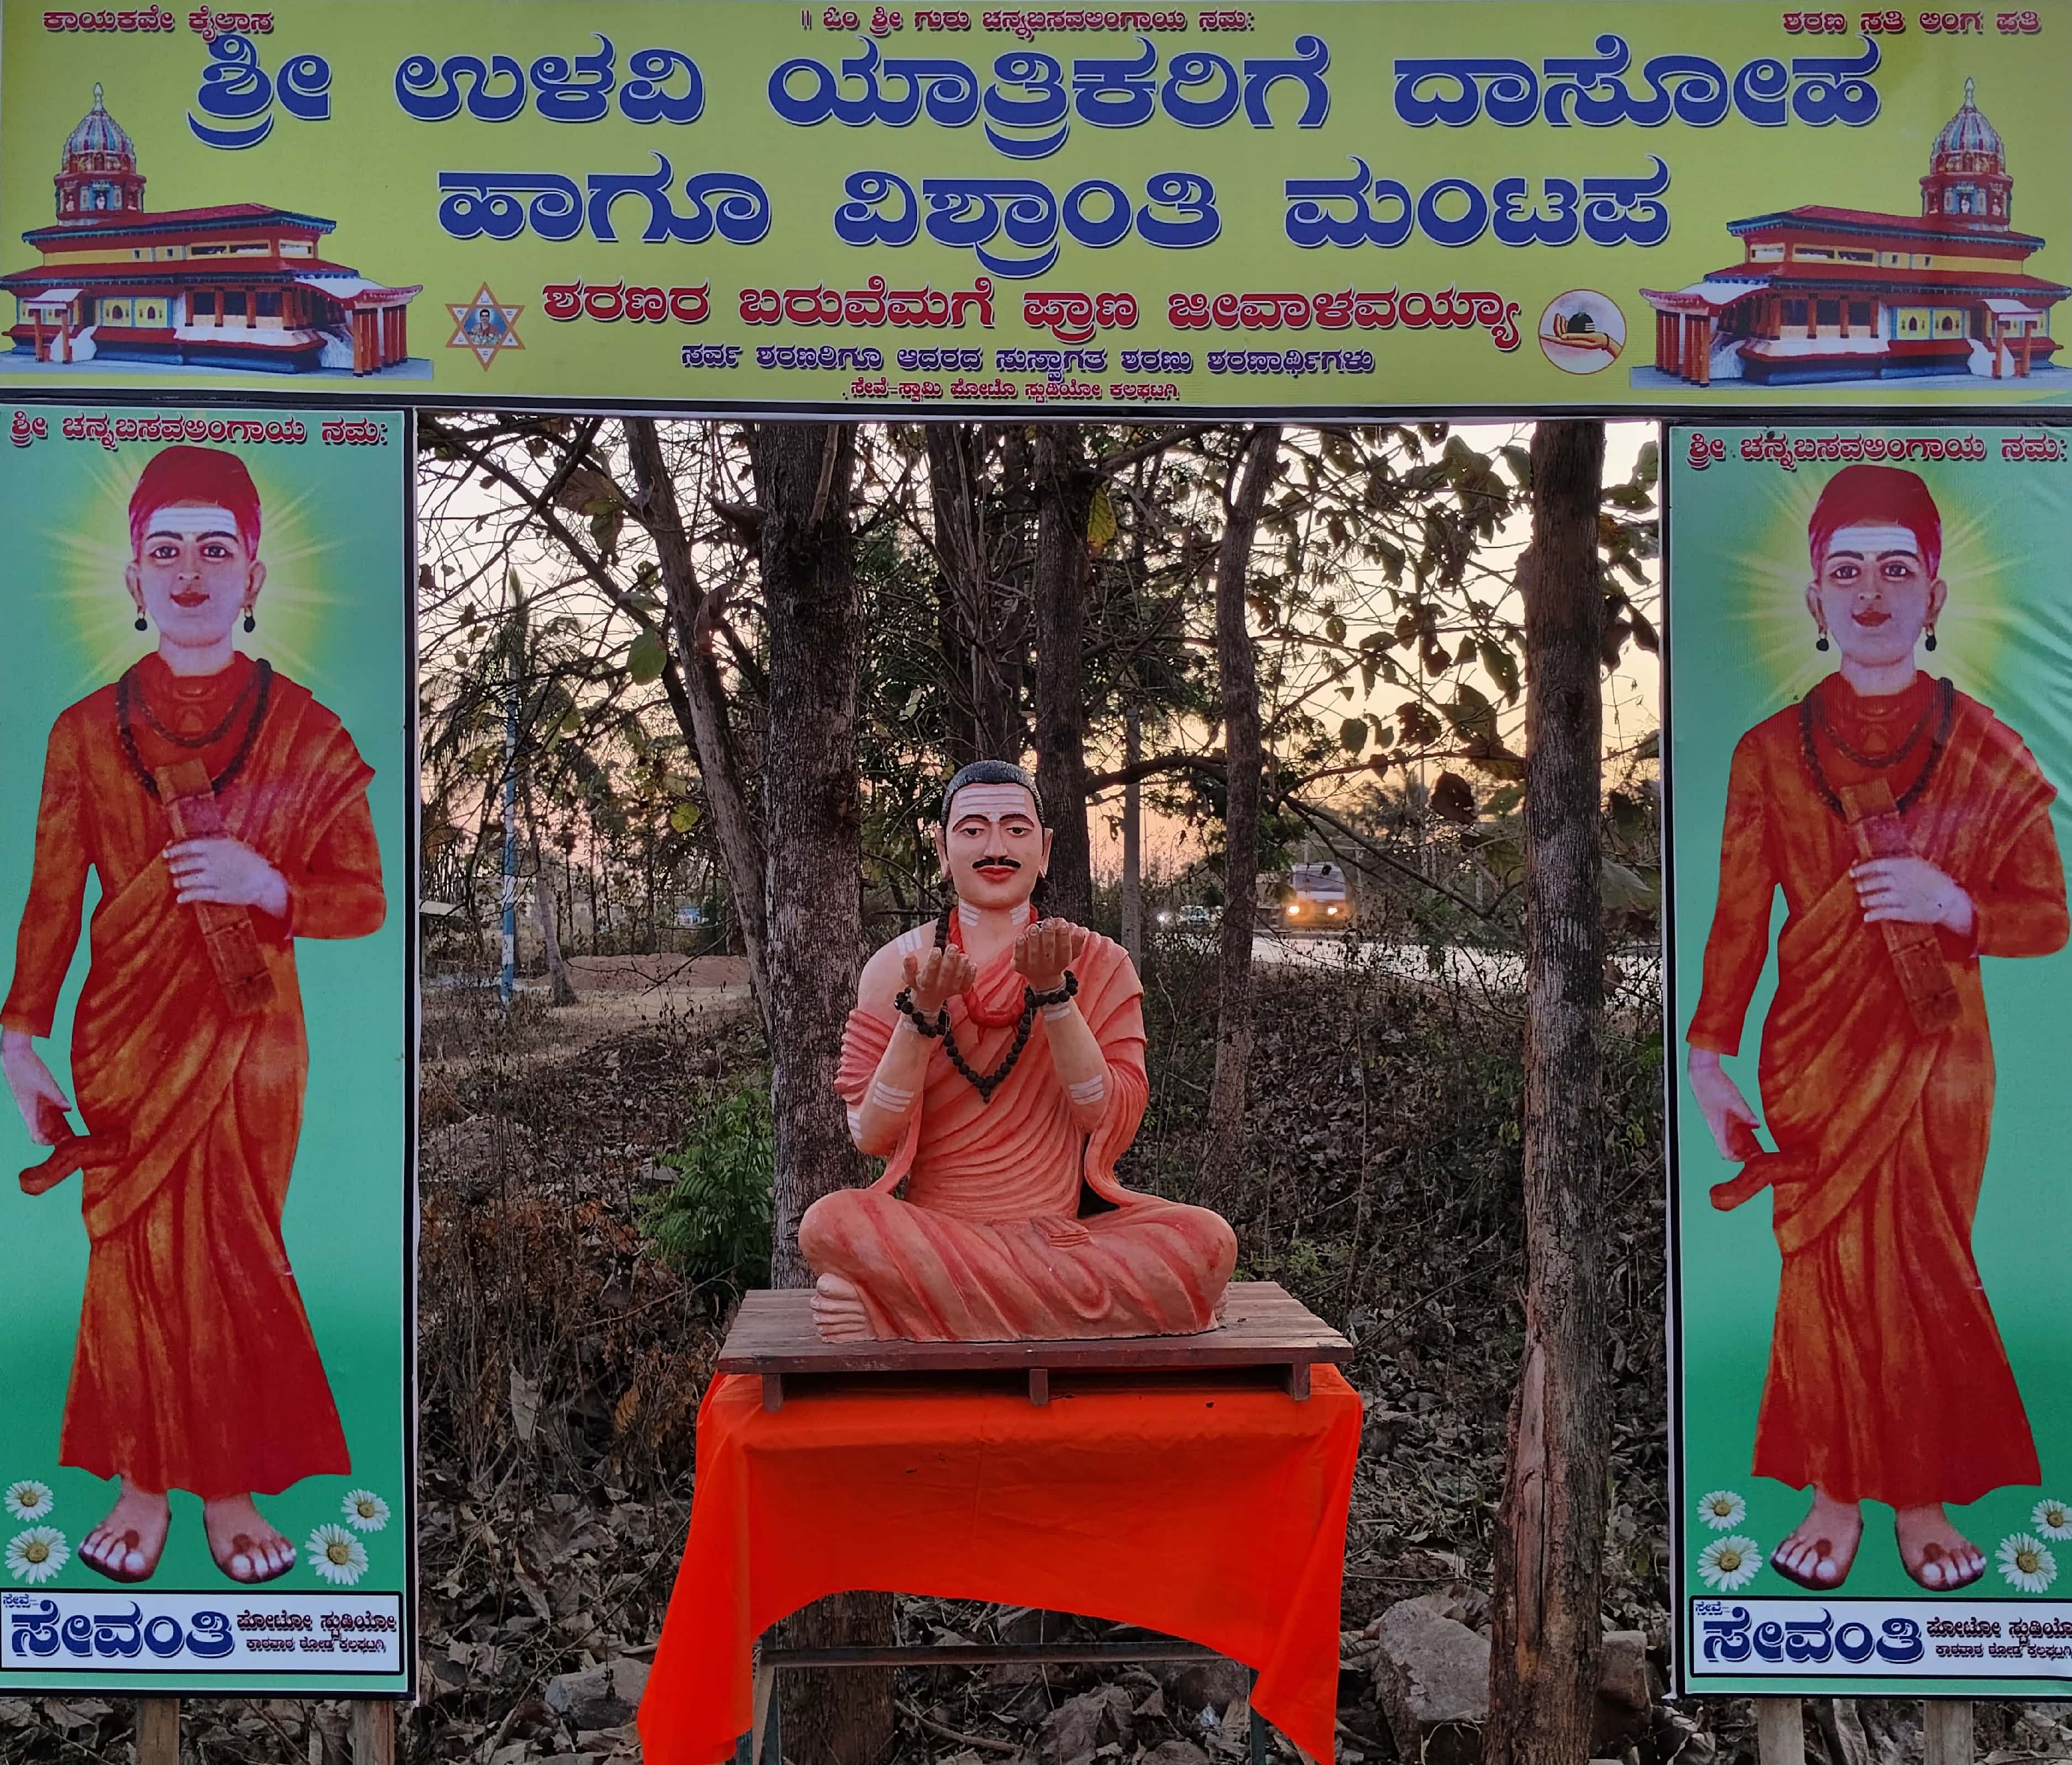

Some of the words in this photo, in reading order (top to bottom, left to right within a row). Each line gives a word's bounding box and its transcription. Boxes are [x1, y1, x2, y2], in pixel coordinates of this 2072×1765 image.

[43, 4, 175, 32] ಕಾಯಕವೇ
[189, 6, 274, 41] ಕೈಲಾಸ
[823, 8, 859, 29] ಓಂ
[870, 6, 903, 35] ಶ್ರೀ
[914, 8, 971, 30] ಗುರು
[983, 8, 1187, 40] ಚನ್ನಬಸವಲಿಂಗಾಯ
[1782, 10, 1847, 34] ಶರಣ
[1860, 9, 1906, 34] ಸತಿ
[1919, 10, 1984, 33] ಲಿಂಗ
[1996, 9, 2041, 34] ಪತಿ
[188, 32, 332, 150] ಶ್ರೀ
[395, 32, 705, 124] ಉಳವಿ
[768, 34, 1330, 159] ಯಾತ್ರಿಕರಿಗೆ
[1394, 34, 1881, 128] ದಾಸೋಹ
[438, 151, 772, 245] ಹಾಗೂ
[834, 170, 1221, 279] ವಿಶ್ರಾಂತಿ
[1285, 154, 1670, 248] ಮಂಟಪ
[542, 276, 710, 323] ಶರಣರ
[739, 275, 995, 328] ಬರುವೆಮಗೆ
[1023, 290, 1139, 343] ಪ್ರಾಣ
[1168, 281, 1521, 352] ಜೀವಾಳವಯ್ಯಾ
[681, 342, 742, 369] ಸರ್ವ
[755, 341, 883, 371] ಶರಣರಿಗೂ
[897, 345, 984, 372] ಆದರದ
[996, 347, 1108, 382] ಸುಸ್ವಾಗತ
[1121, 347, 1194, 373] ಶರಣು
[1207, 347, 1375, 377] ಶರಣಾರ್ಥಿಗಳು
[10, 411, 48, 447] ಶ್ರೀ
[62, 412, 307, 450] ಚನ್ನಬಸವಲಿಂಗಾಯ
[1687, 432, 1726, 471] ಶ್ರೀ
[1740, 433, 1987, 472] ಚನ್ನಬಸವಲಿಂಗಾಯ
[11, 1599, 235, 1658] ಸೇವಂತಿ
[1703, 1606, 1924, 1665] ಸೇವಂತಿ
